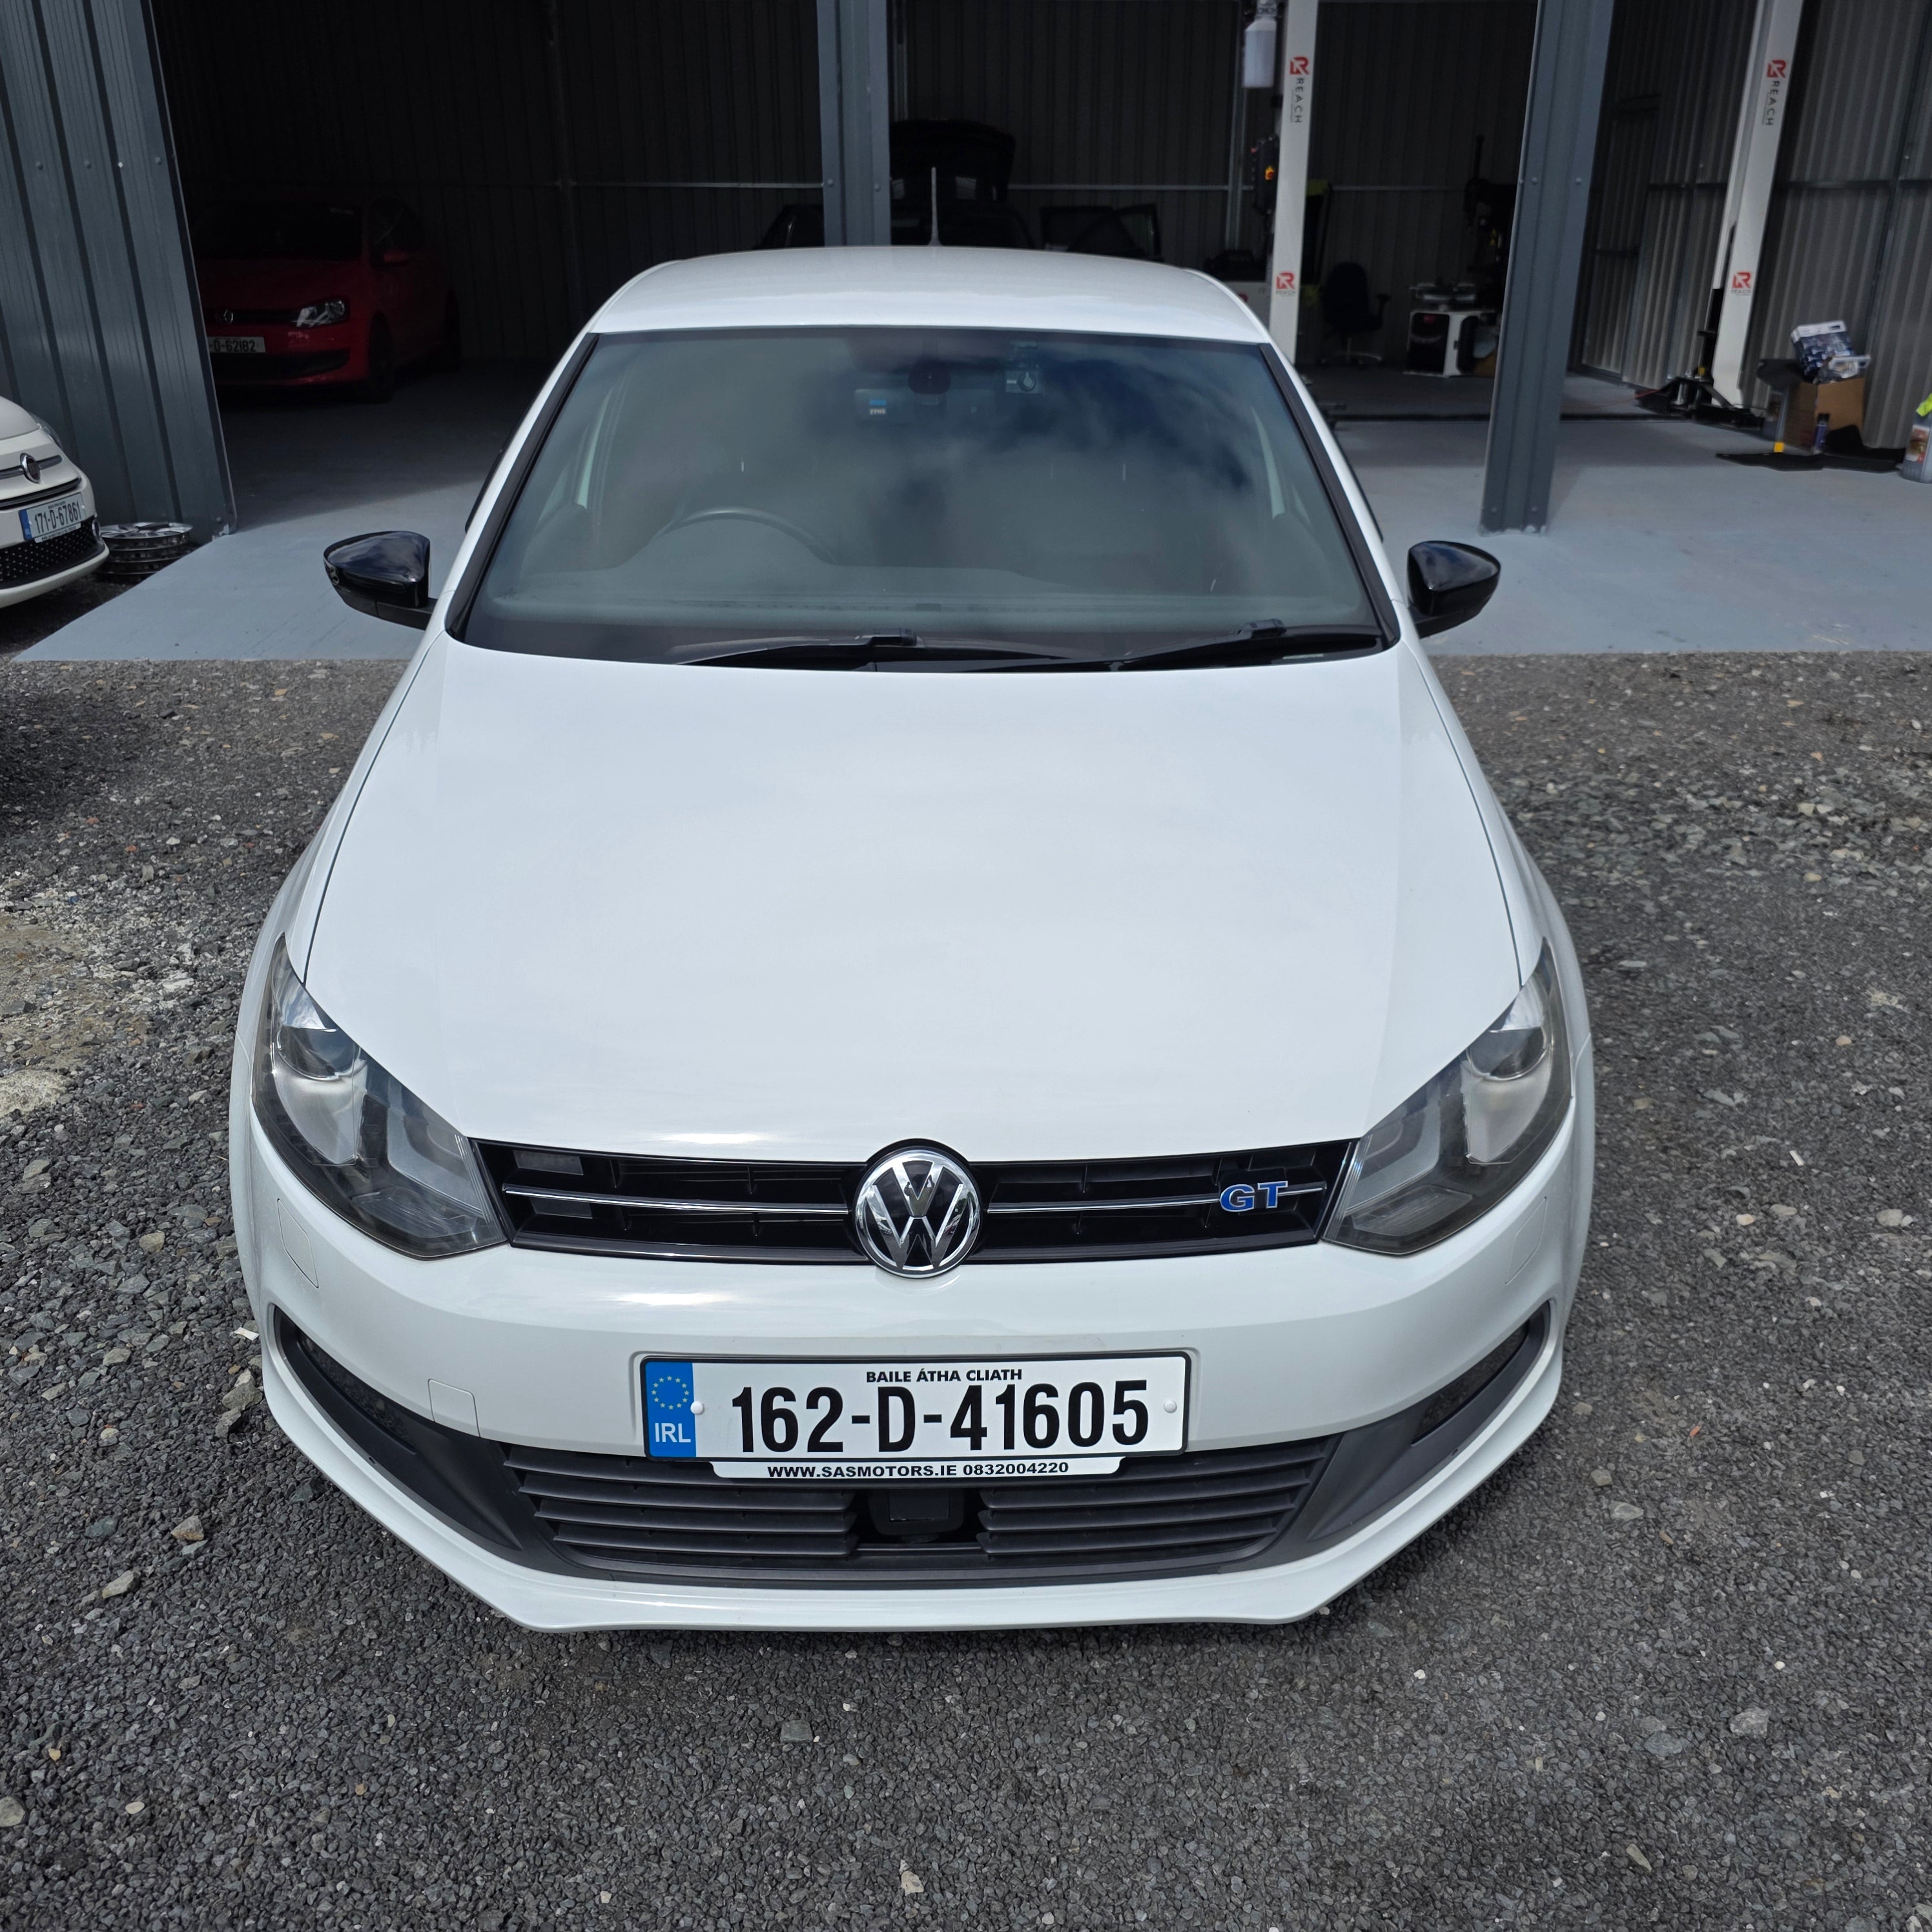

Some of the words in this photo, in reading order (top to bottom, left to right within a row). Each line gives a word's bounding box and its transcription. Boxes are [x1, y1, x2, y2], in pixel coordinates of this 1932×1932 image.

[1294, 77, 1304, 123] REACH
[1765, 80, 1780, 126] REACH
[34, 500, 82, 535] 171-D-67861
[1219, 1180, 1288, 1213] GT
[866, 1371, 911, 1382] BAILE
[916, 1368, 961, 1382] ÁTHA
[966, 1369, 1022, 1381] CLIATH
[654, 1423, 691, 1443] IRL
[732, 1379, 1149, 1453] 162-D-41605
[767, 1464, 957, 1477] WWW.SASMOTORS.IE
[963, 1462, 1069, 1475] 0832004220
